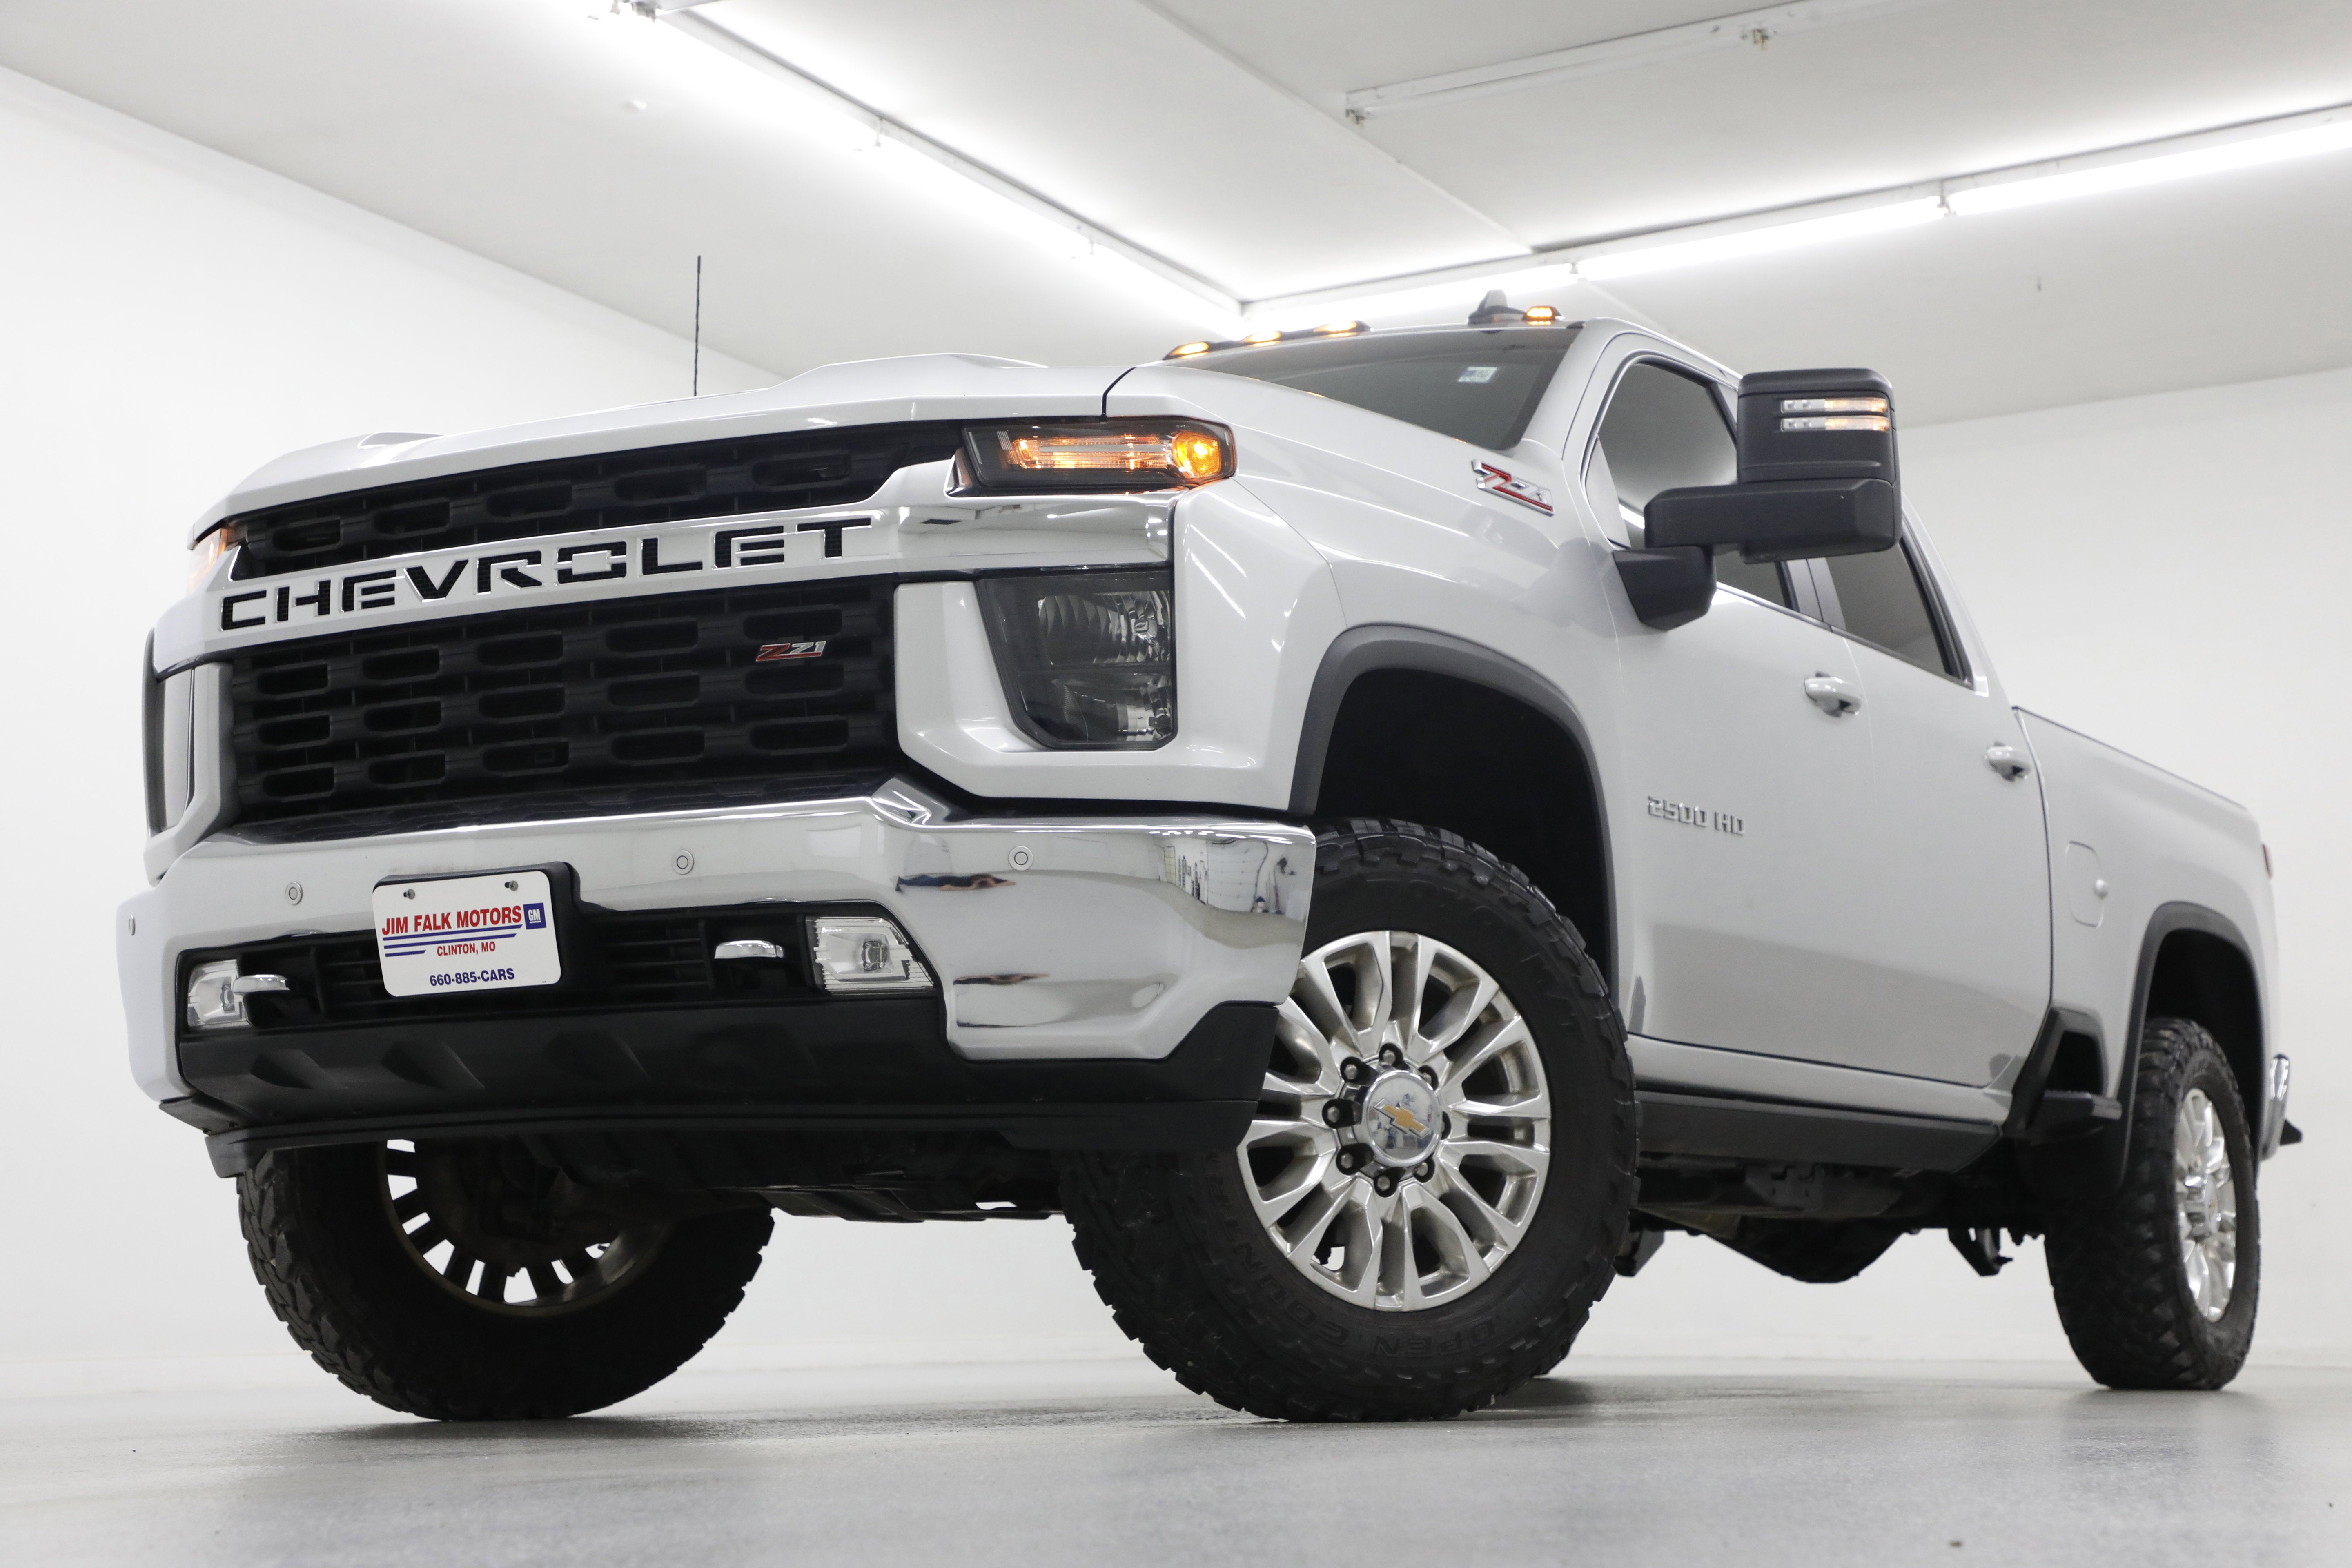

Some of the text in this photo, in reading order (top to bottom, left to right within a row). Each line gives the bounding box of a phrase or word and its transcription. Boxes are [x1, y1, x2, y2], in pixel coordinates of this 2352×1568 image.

[1471, 459, 1555, 517] Z71
[220, 517, 872, 632] CHEVROLET
[756, 641, 826, 662] Z71
[1648, 796, 1745, 836] 2500 HD
[382, 905, 522, 935] JIM FALK MOTORS
[528, 909, 541, 922] GM
[437, 941, 496, 956] CLINTON, MO
[430, 968, 515, 986] 660-885-CARS
[1370, 1316, 1495, 1358] OPEN
